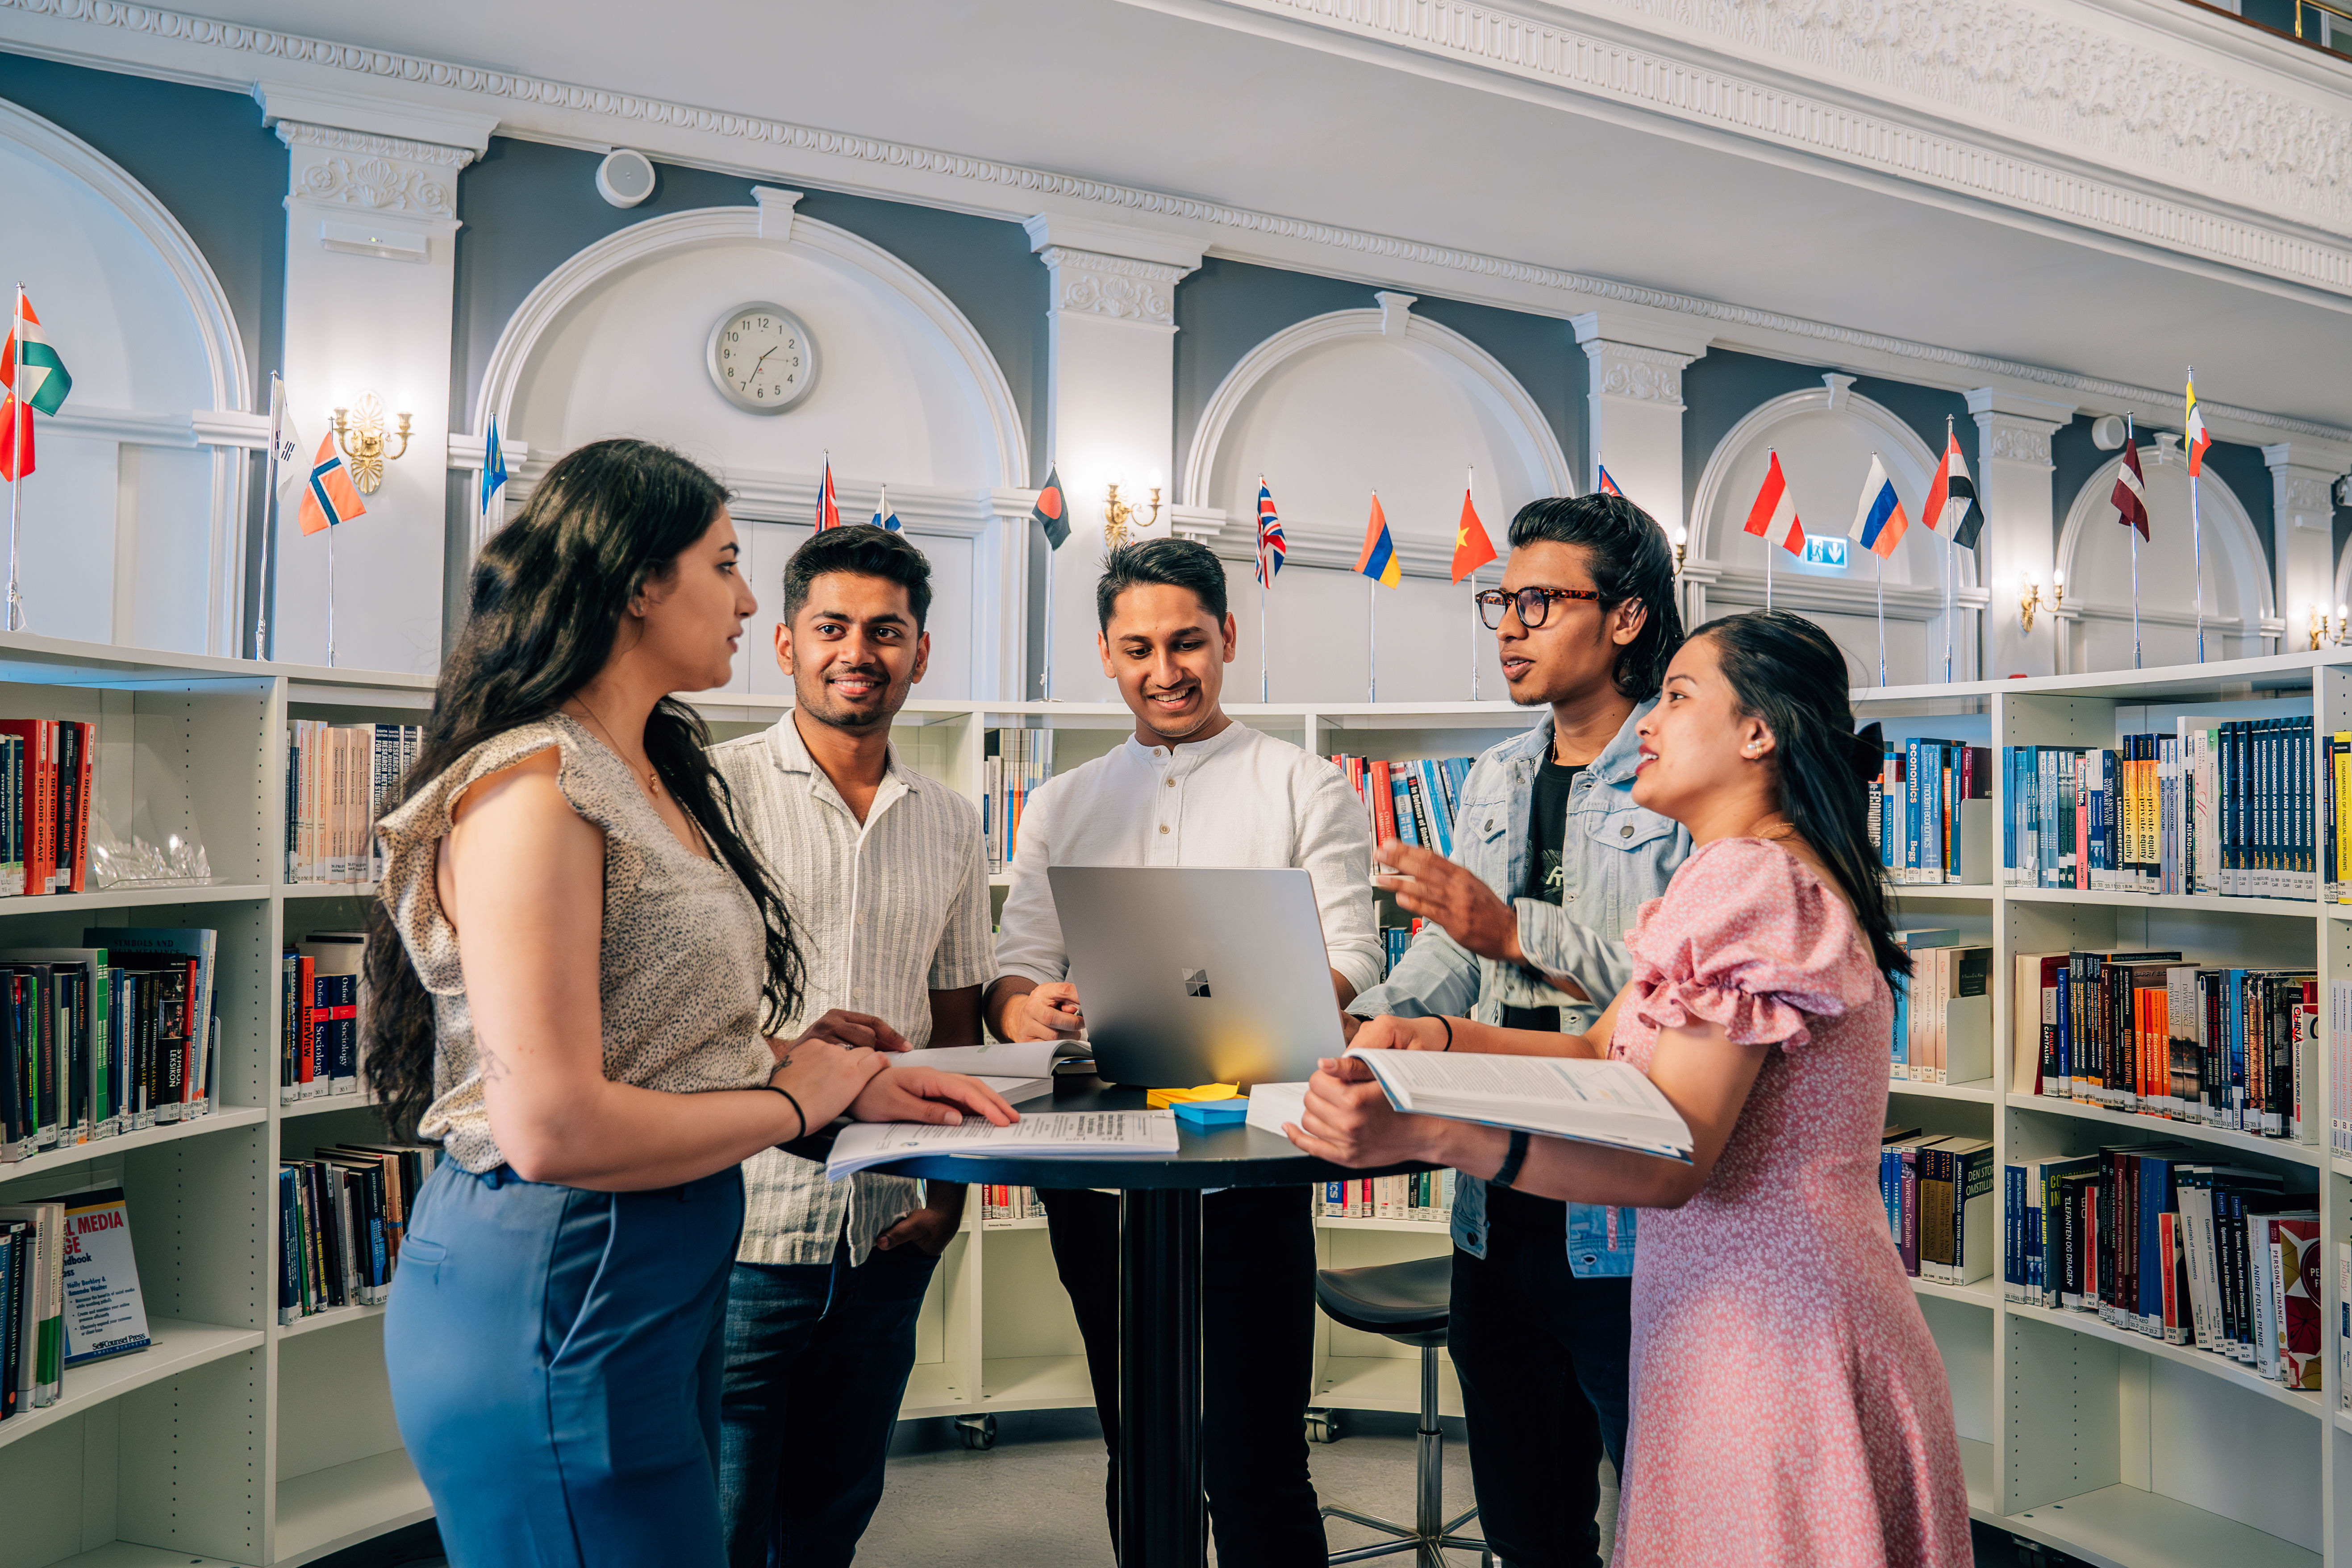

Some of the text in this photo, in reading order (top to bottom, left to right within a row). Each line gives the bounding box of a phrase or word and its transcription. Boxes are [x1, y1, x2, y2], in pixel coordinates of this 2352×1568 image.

[742, 321, 750, 330] 11
[758, 318, 769, 328] 12
[779, 325, 782, 334] 1
[727, 332, 738, 342] 10
[788, 339, 794, 349] 2
[724, 349, 730, 359] 9
[792, 357, 798, 367] 3
[728, 367, 734, 377] 8
[787, 374, 793, 384] 4
[741, 382, 746, 391] 7
[775, 385, 780, 395] 5
[758, 388, 763, 398] 6
[1910, 743, 1919, 803] economics
[1399, 797, 1407, 813] HUTTON
[2124, 799, 2132, 831] private
[1412, 794, 1423, 818] Defense
[1419, 827, 1431, 851] Globaliz
[1908, 841, 1917, 862] Begg
[2125, 835, 2133, 858] equity
[114, 939, 153, 948] SYMBOLS
[2293, 1007, 2302, 1043] CHINA
[340, 1022, 349, 1066] Sociology
[313, 1026, 324, 1076] Sociology
[78, 1211, 124, 1234] MEDIA
[2066, 1242, 2072, 1252] OG
[2273, 1250, 2281, 1289] PERSONAL
[2253, 1264, 2261, 1291] ANDRE
[129, 1333, 146, 1342] Press
